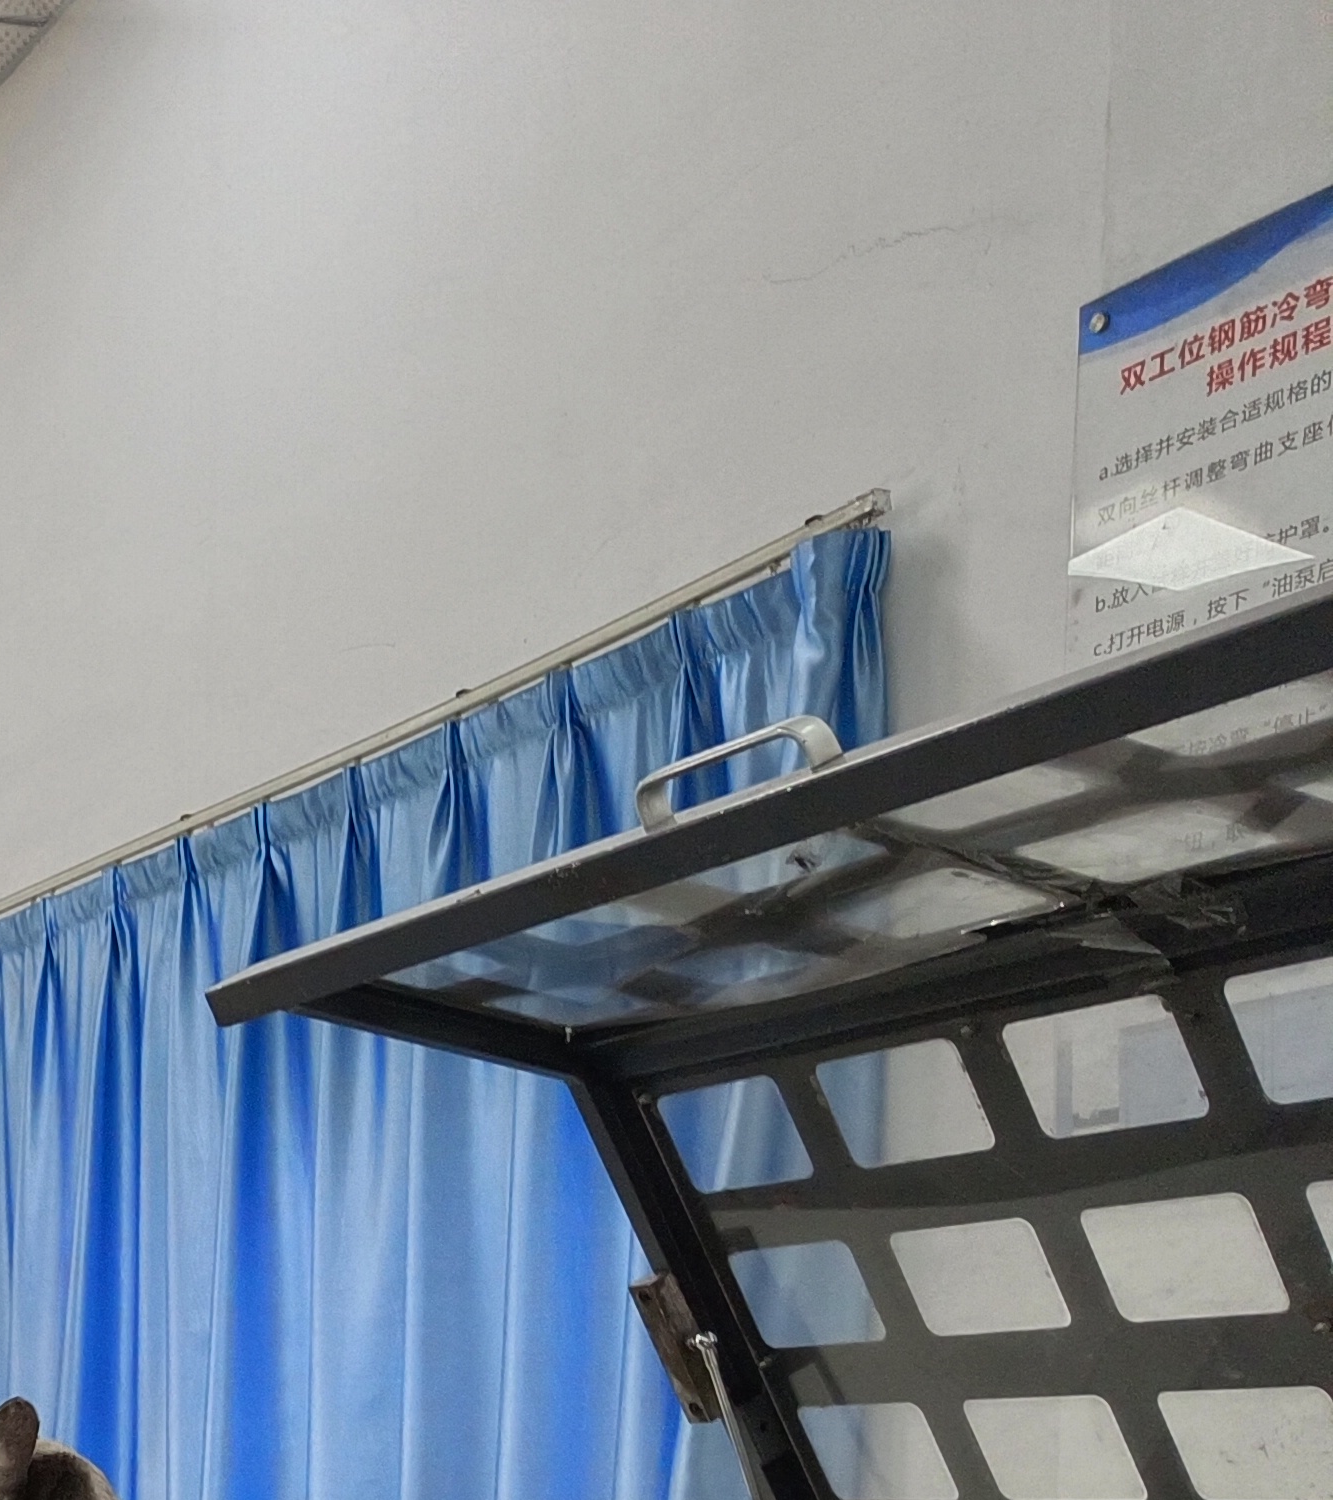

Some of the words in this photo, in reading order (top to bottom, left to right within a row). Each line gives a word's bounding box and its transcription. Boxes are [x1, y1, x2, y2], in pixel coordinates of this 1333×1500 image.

[1120, 275, 1333, 396] 双工位钢筋冷弯
[1206, 316, 1332, 398] 操作规程
